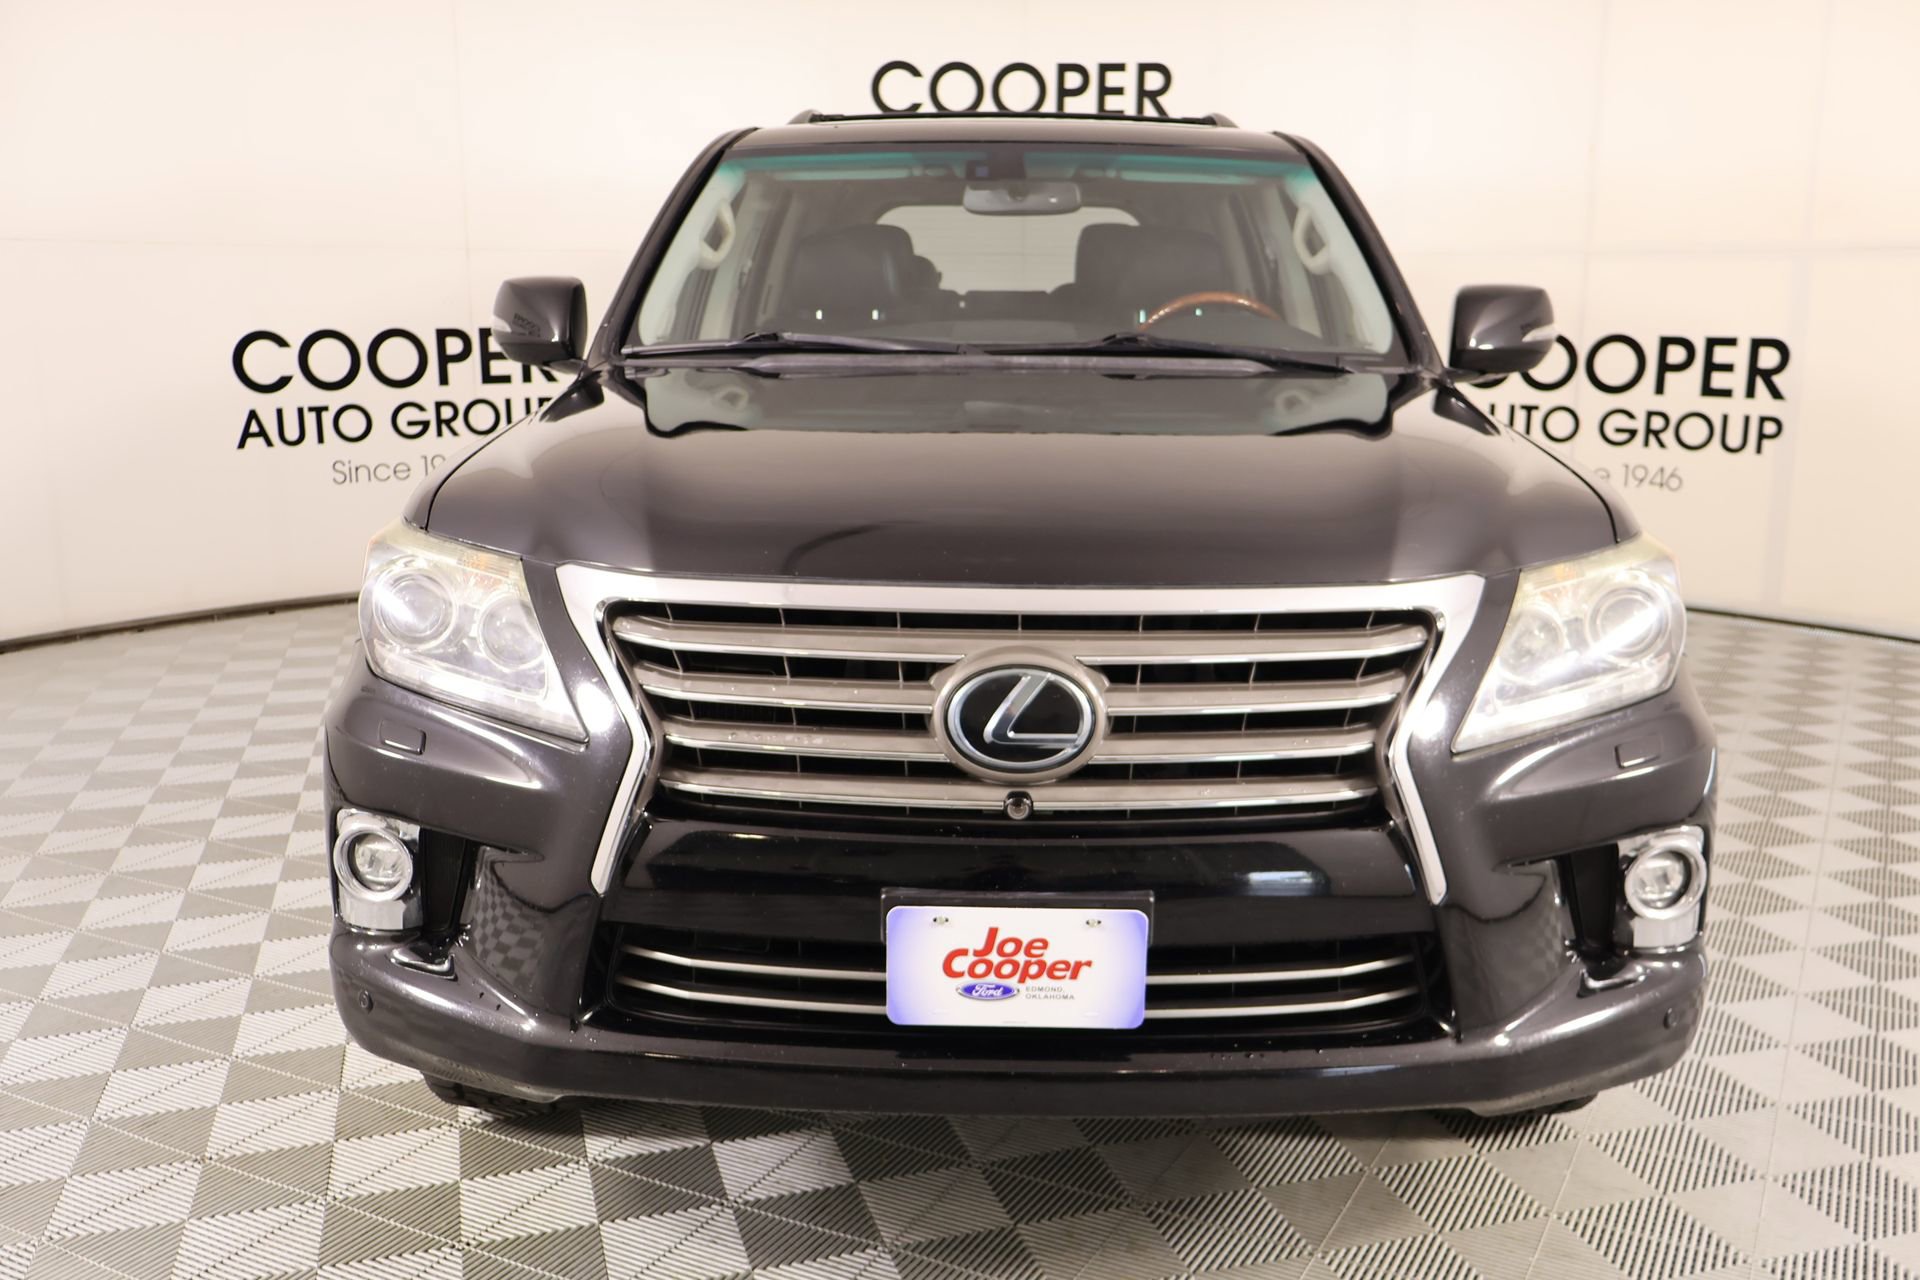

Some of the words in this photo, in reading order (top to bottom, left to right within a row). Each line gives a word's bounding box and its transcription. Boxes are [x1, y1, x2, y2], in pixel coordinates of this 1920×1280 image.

[871, 60, 1172, 115] COOPER
[232, 328, 558, 394] COOPE
[1470, 333, 1791, 400] OOPER
[236, 404, 373, 450] AUTO
[390, 397, 553, 440] GROU
[1597, 408, 1784, 455] GROUP
[331, 459, 411, 486] Since
[1622, 463, 1683, 493] 1946
[972, 927, 1049, 959] Joe
[942, 947, 1093, 984] Cooper
[971, 983, 1004, 998] Ford
[1025, 993, 1075, 1001] OKLAHOMA
